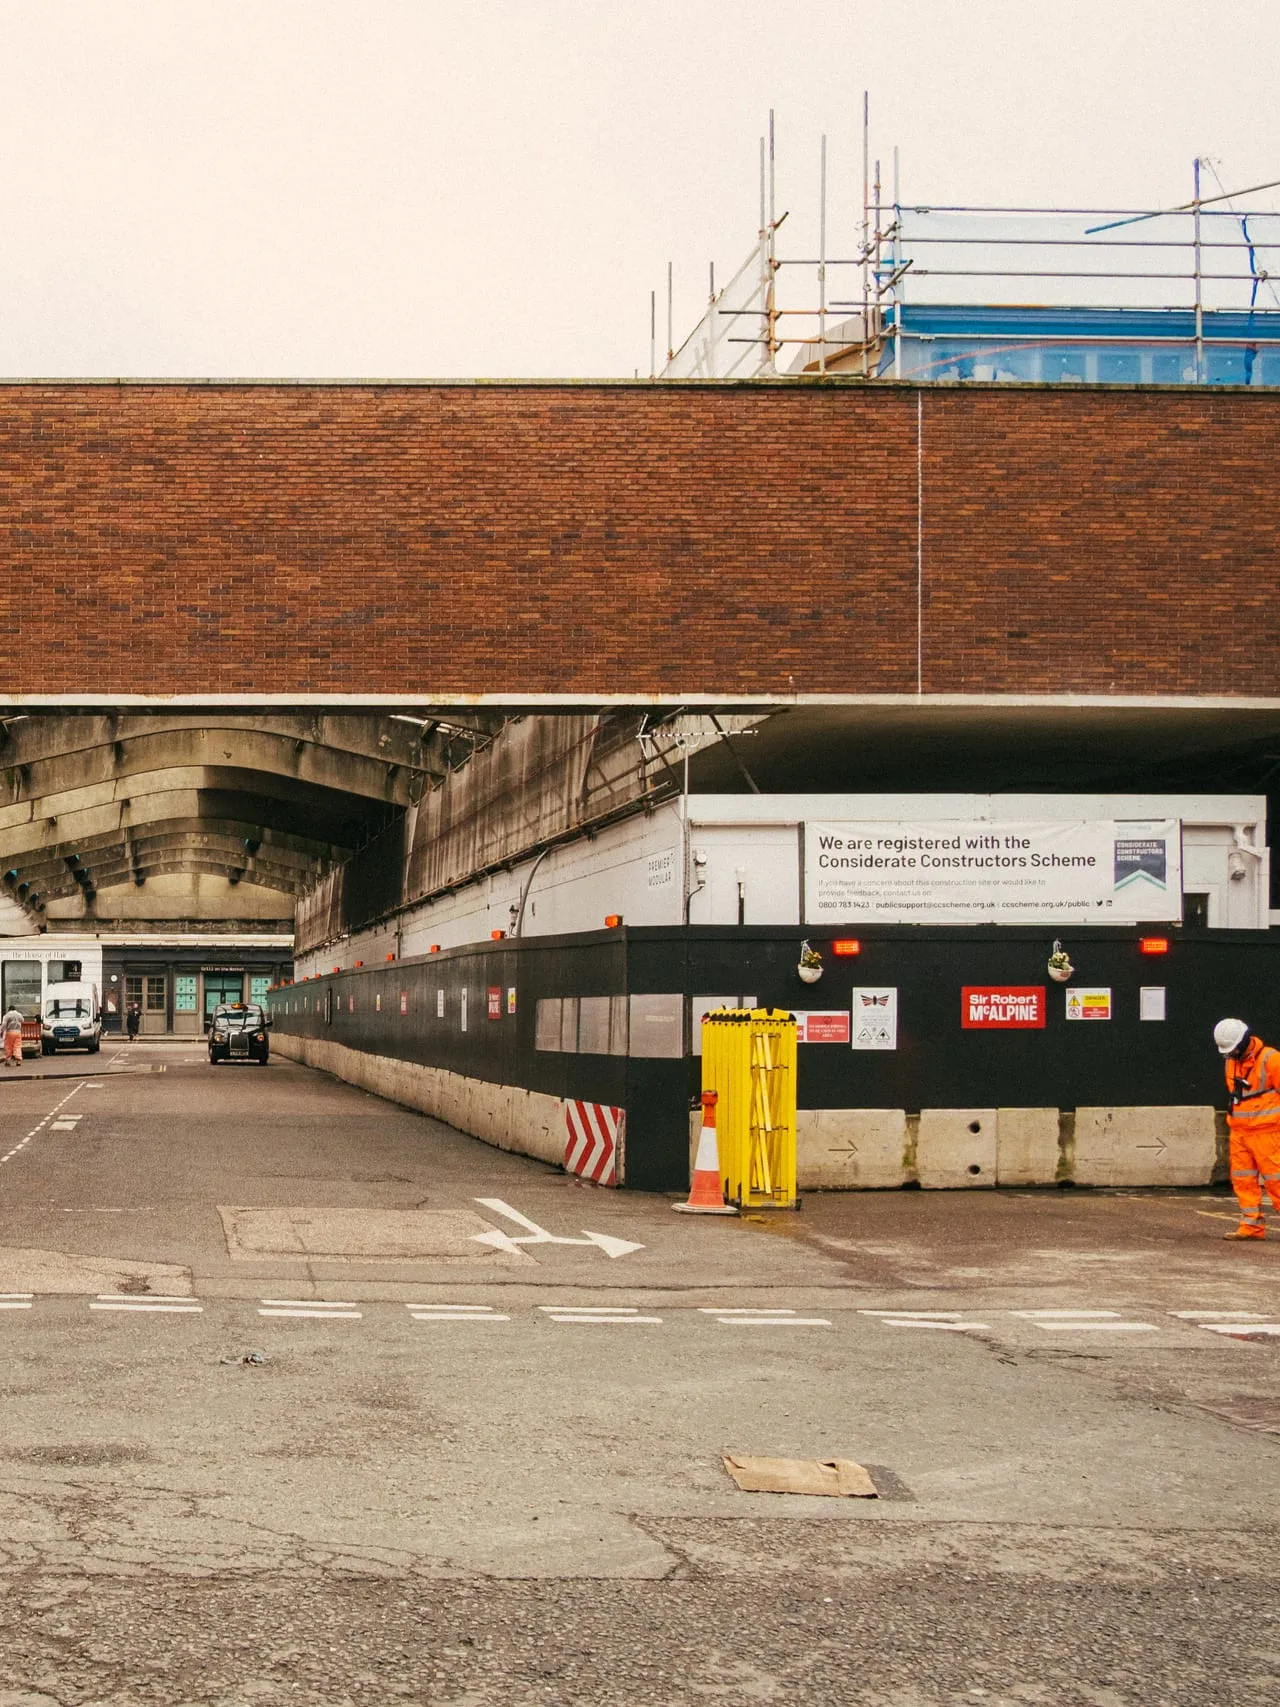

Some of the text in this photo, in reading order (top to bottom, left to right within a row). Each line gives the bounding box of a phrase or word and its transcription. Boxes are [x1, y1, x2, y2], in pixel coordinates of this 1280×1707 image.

[818, 835, 1031, 853] We are registered with the
[818, 853, 1097, 868] Considerate Constructors Scheme
[818, 901, 837, 909] 0800
[839, 901, 852, 909] 783
[875, 900, 996, 910] publicsupport@ccscheme.org.uk
[1001, 899, 1090, 909] ccscheme.org.uk/public
[24, 951, 42, 959] House
[45, 951, 52, 959] of
[53, 951, 67, 959] Hair
[969, 994, 1038, 1004] Sir Robert
